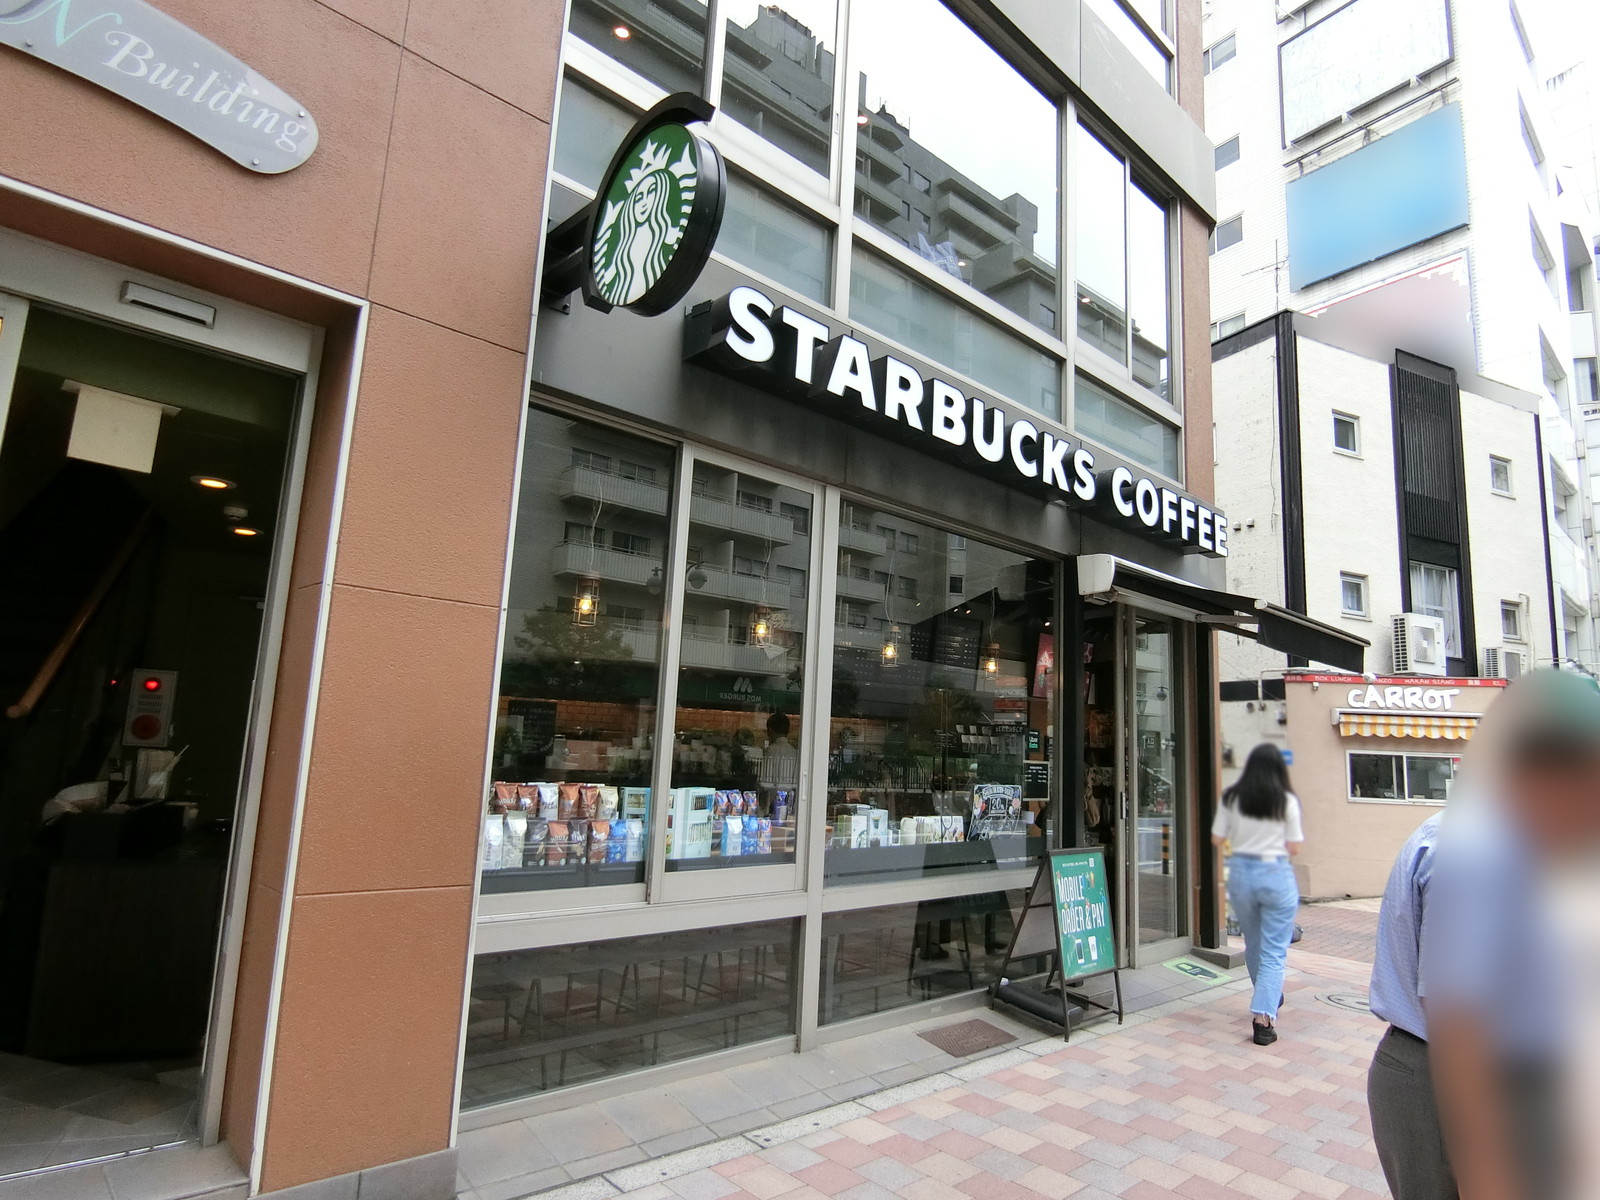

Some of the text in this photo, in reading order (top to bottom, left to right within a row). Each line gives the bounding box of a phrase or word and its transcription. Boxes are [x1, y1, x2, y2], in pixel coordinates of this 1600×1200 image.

[102, 30, 307, 154] Building
[725, 286, 1229, 558] STARBUCKS COFFEE
[1347, 685, 1460, 710] CARROT
[1058, 875, 1085, 903] MOBILE
[1061, 902, 1105, 934] ORDER & PAY
